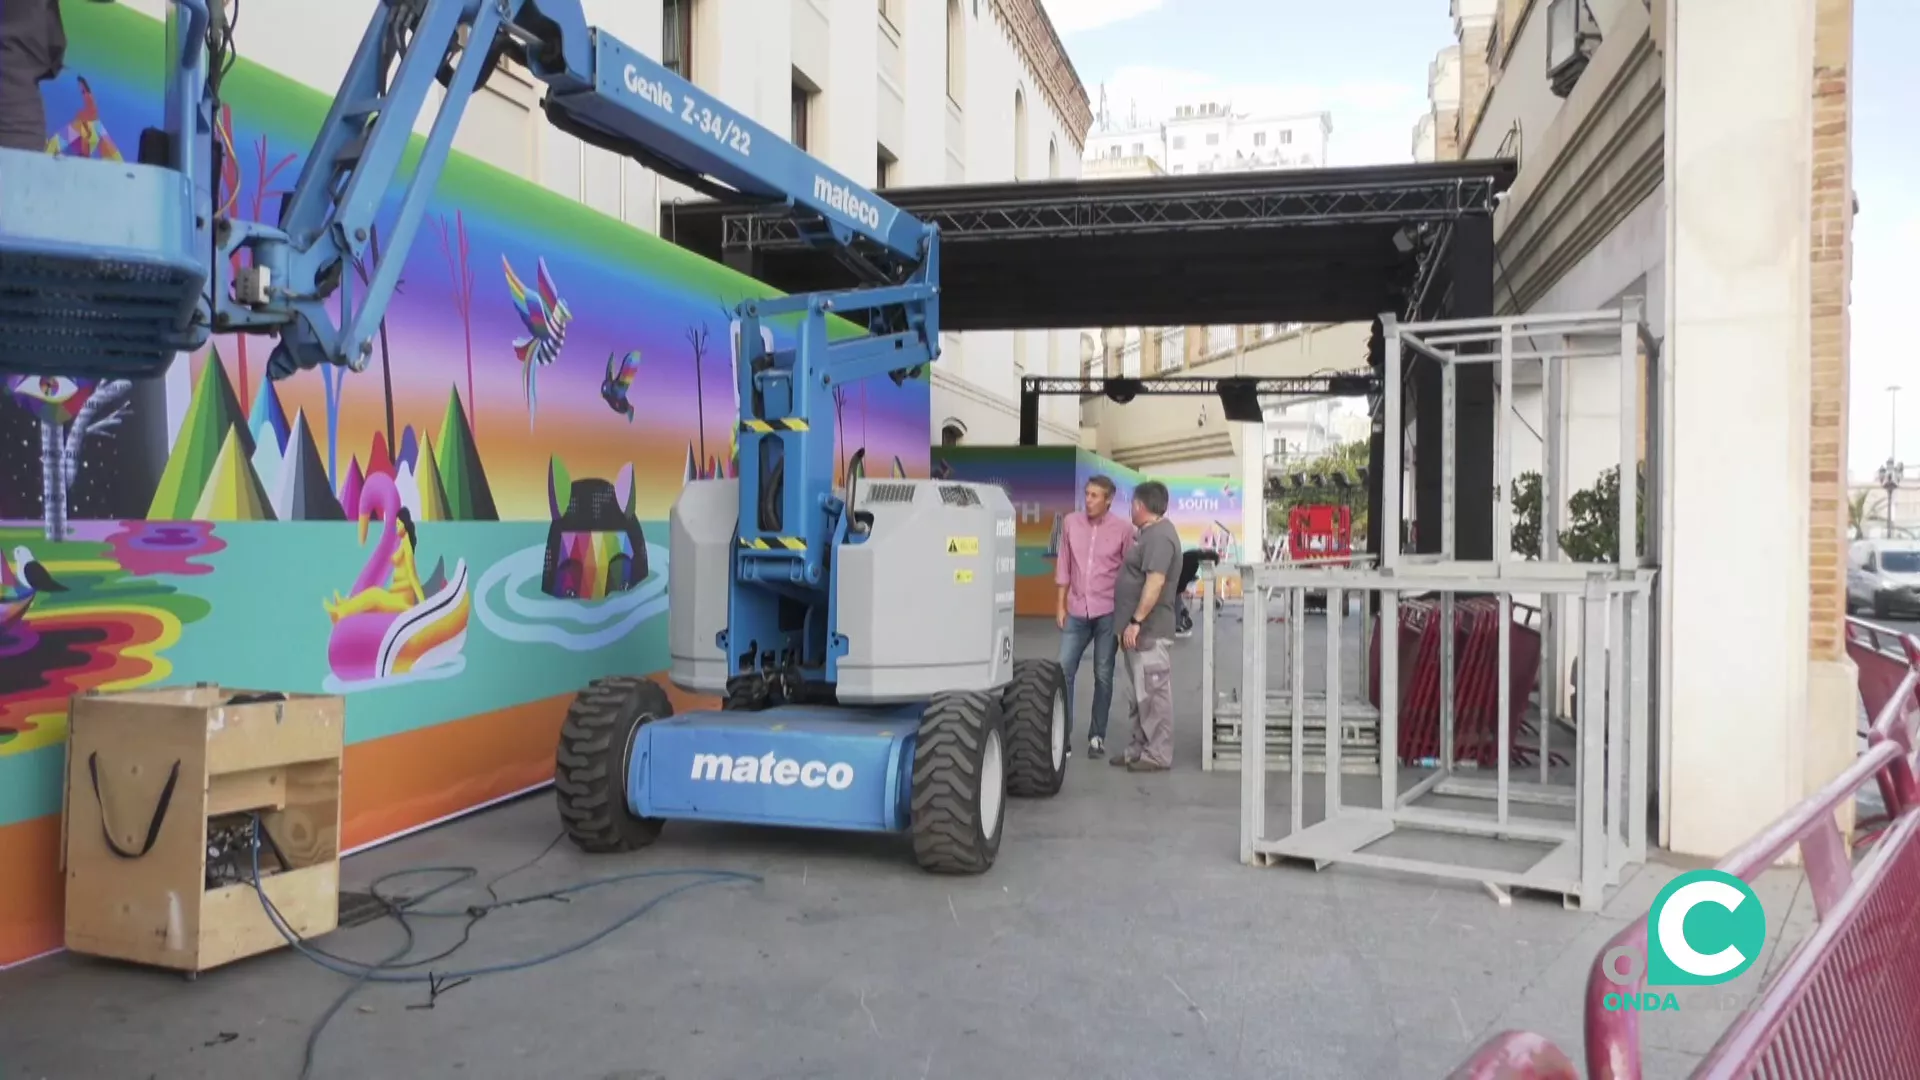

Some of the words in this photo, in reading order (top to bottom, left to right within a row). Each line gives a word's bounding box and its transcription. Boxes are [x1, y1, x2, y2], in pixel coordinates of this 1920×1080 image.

[623, 63, 675, 114] Genie
[681, 95, 751, 156] Z-34/22
[813, 174, 880, 230] mateco
[1178, 498, 1219, 511] SOUTH
[690, 751, 854, 790] mateco
